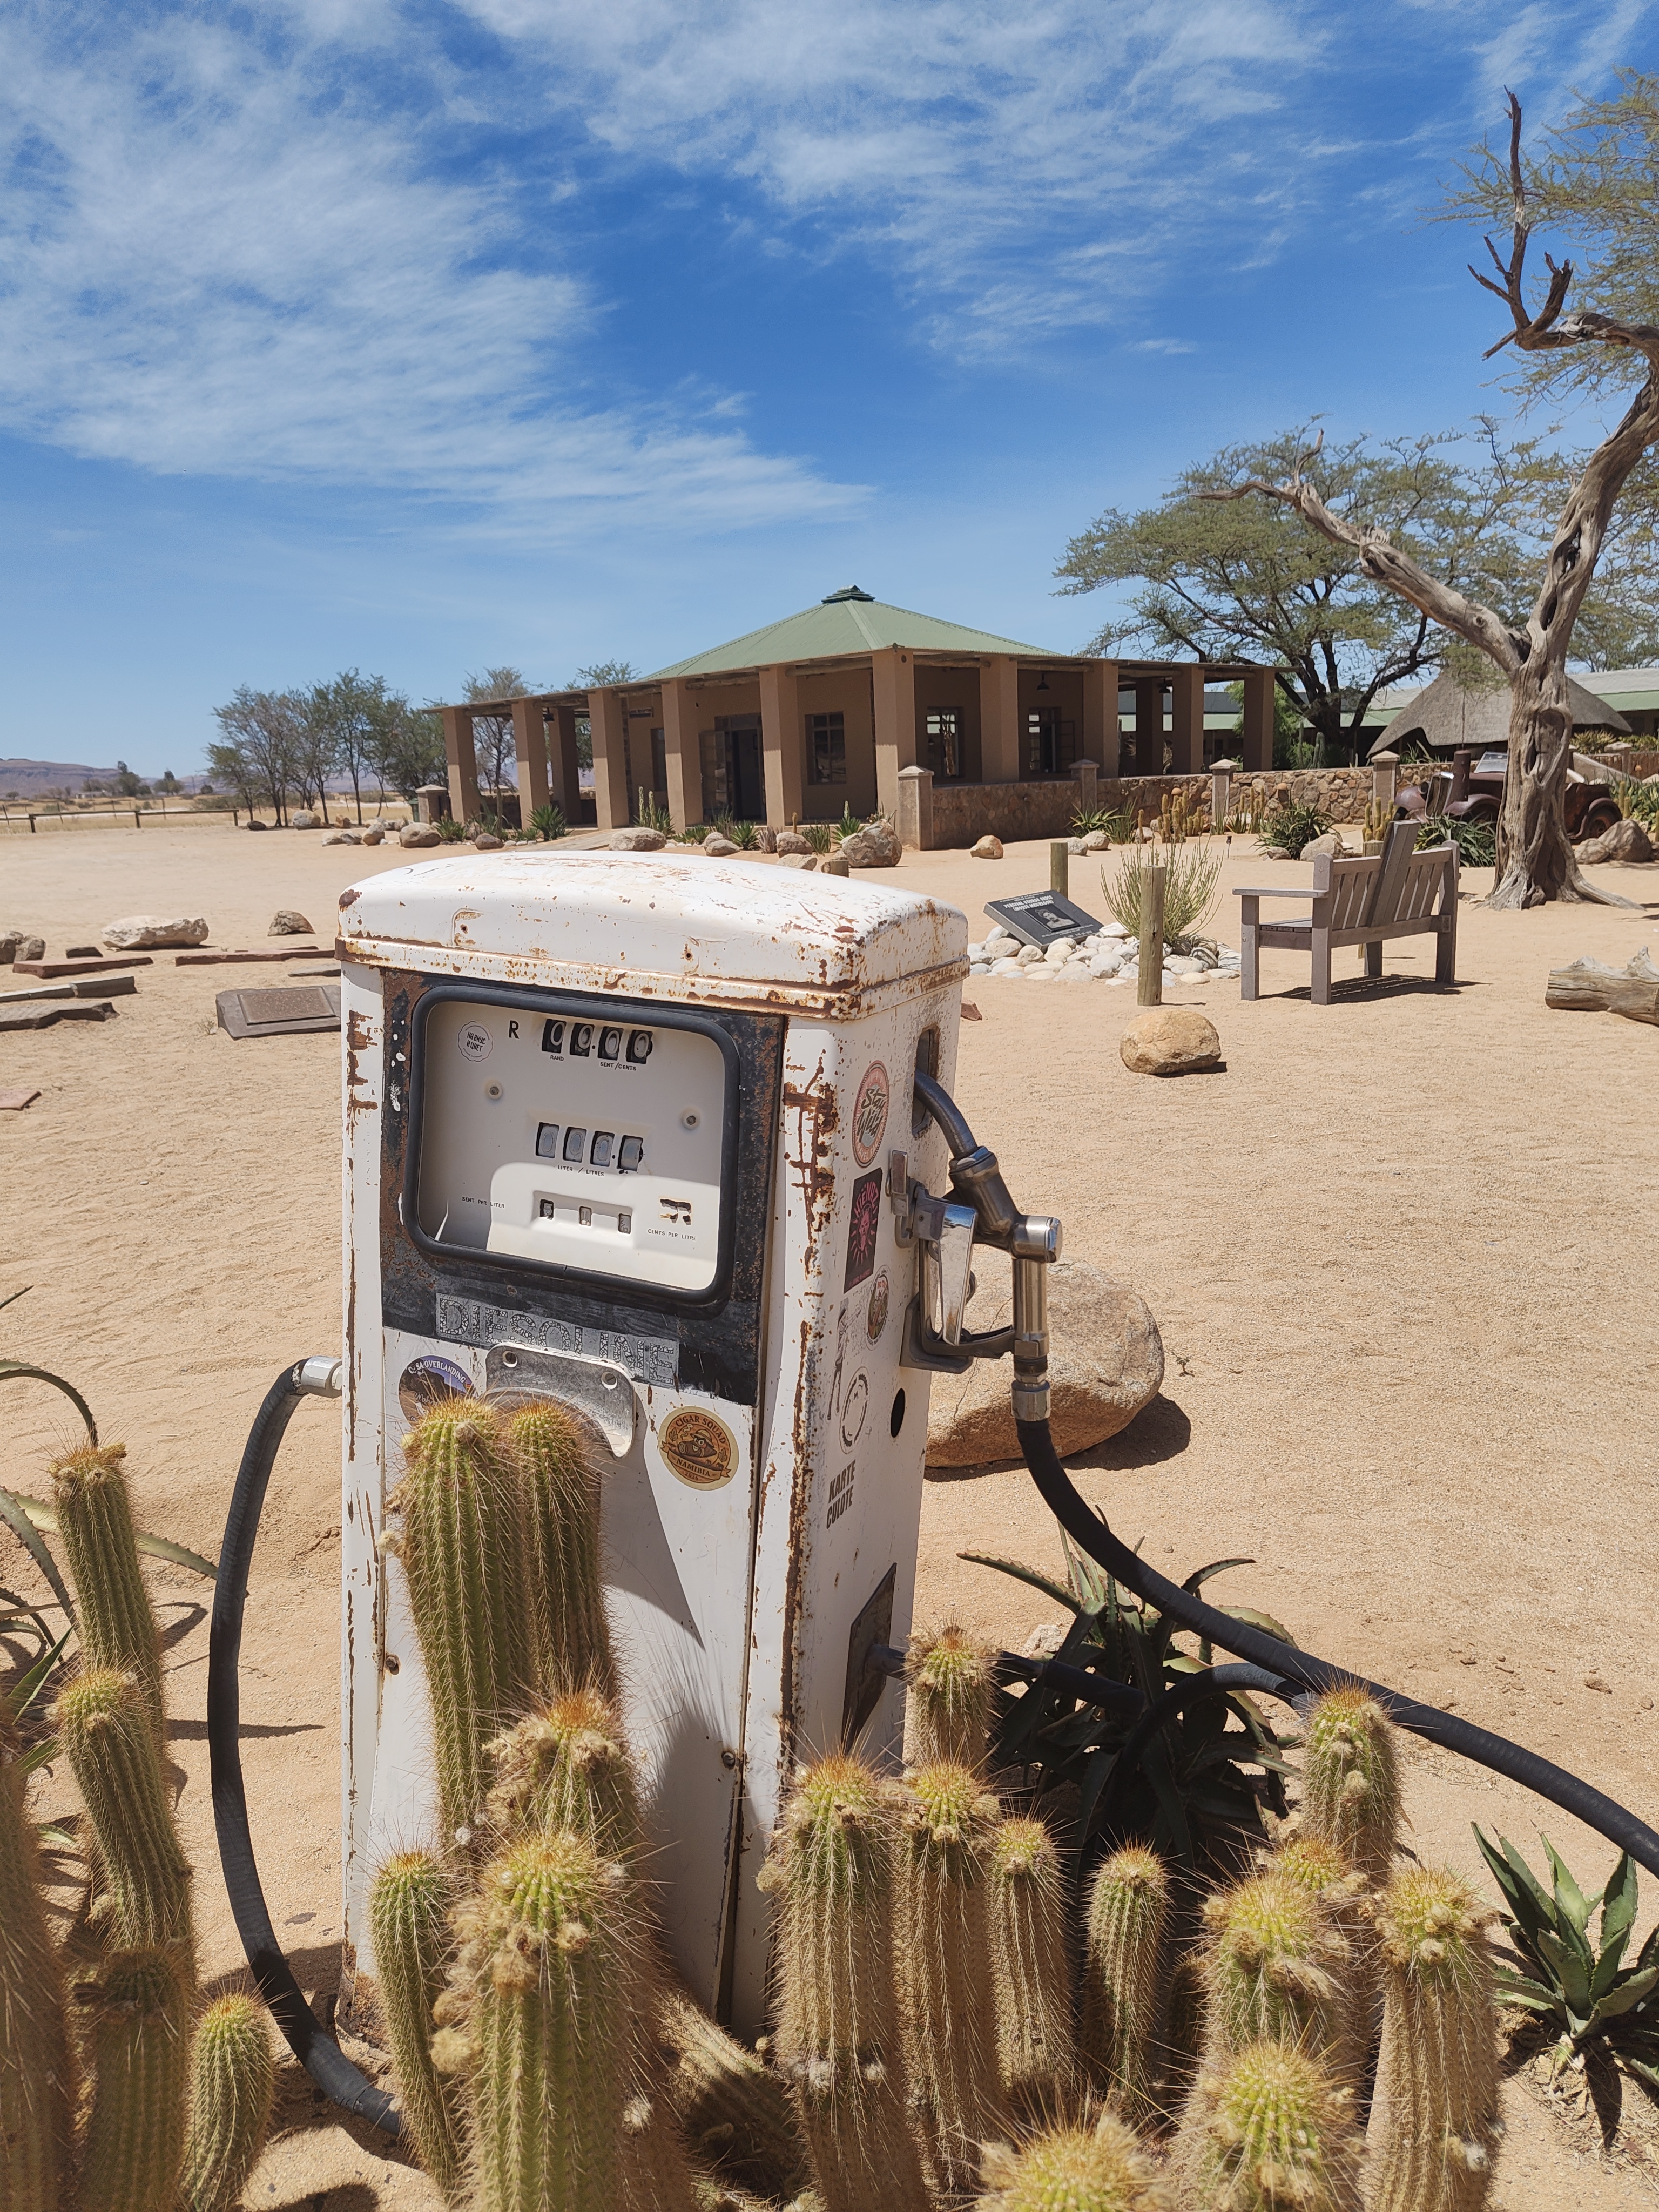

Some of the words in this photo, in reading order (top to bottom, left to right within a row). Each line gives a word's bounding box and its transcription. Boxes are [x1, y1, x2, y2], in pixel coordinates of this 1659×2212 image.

[467, 1031, 474, 1040] НА
[474, 1034, 486, 1045] ВКУС
[509, 1020, 520, 1039] R
[470, 1042, 483, 1052] ЦВЕТ
[861, 1088, 886, 1121] Stay
[857, 1108, 884, 1143] Wild
[424, 1360, 466, 1383] OVERLANDING
[676, 1415, 700, 1427] CIGAR
[702, 1418, 726, 1444] SQUAD
[677, 1459, 710, 1476] NAMIBIA
[685, 1472, 699, 1481] 2026
[828, 1459, 856, 1503] KARTE
[826, 1484, 854, 1529] CULOTE
